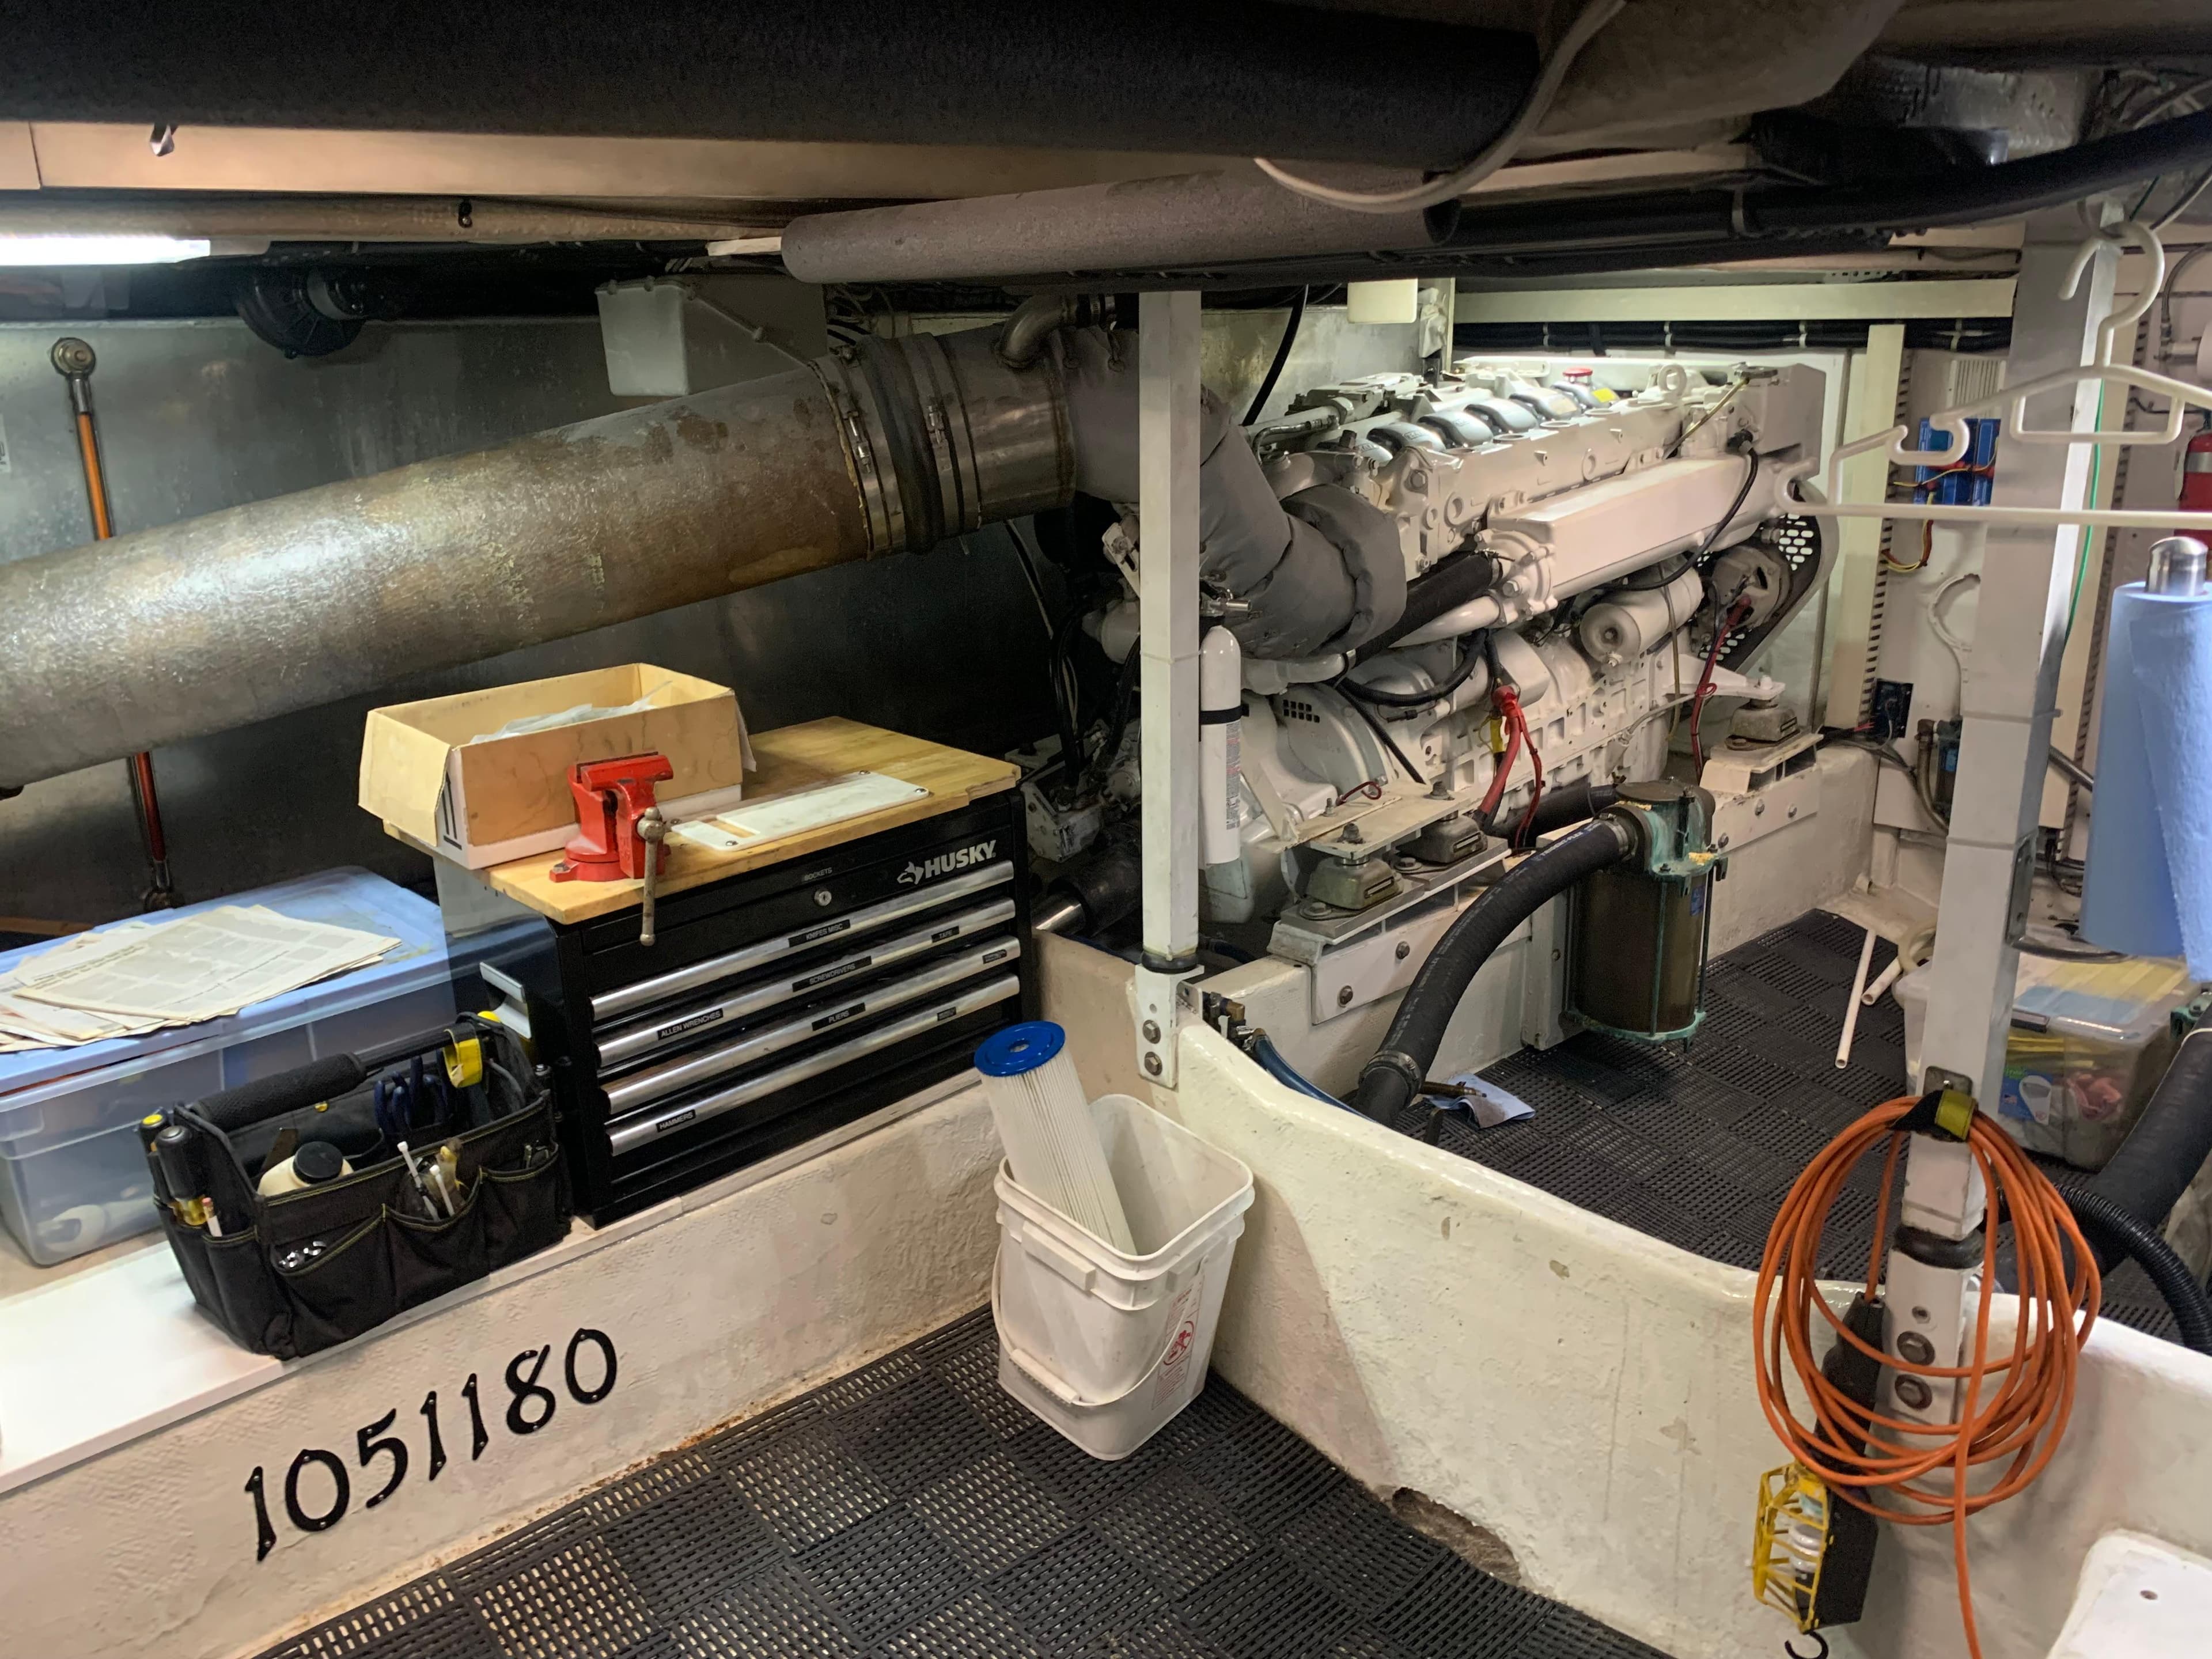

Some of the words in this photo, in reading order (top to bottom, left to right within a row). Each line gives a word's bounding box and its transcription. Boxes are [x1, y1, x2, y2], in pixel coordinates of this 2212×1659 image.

[924, 839, 997, 879] HUSKY
[804, 867, 833, 881] SOCKETS
[806, 927, 828, 941] KNIFES
[828, 923, 843, 934] MISC
[938, 930, 953, 939] TAPE
[809, 963, 856, 985] SCREWDRIVERS
[661, 1024, 683, 1037] ALLEN
[683, 1010, 721, 1029] WRENCHES
[828, 1010, 850, 1024] PLIERS
[659, 1112, 694, 1130] HAMMERS
[244, 1327, 618, 1563] 1051180
